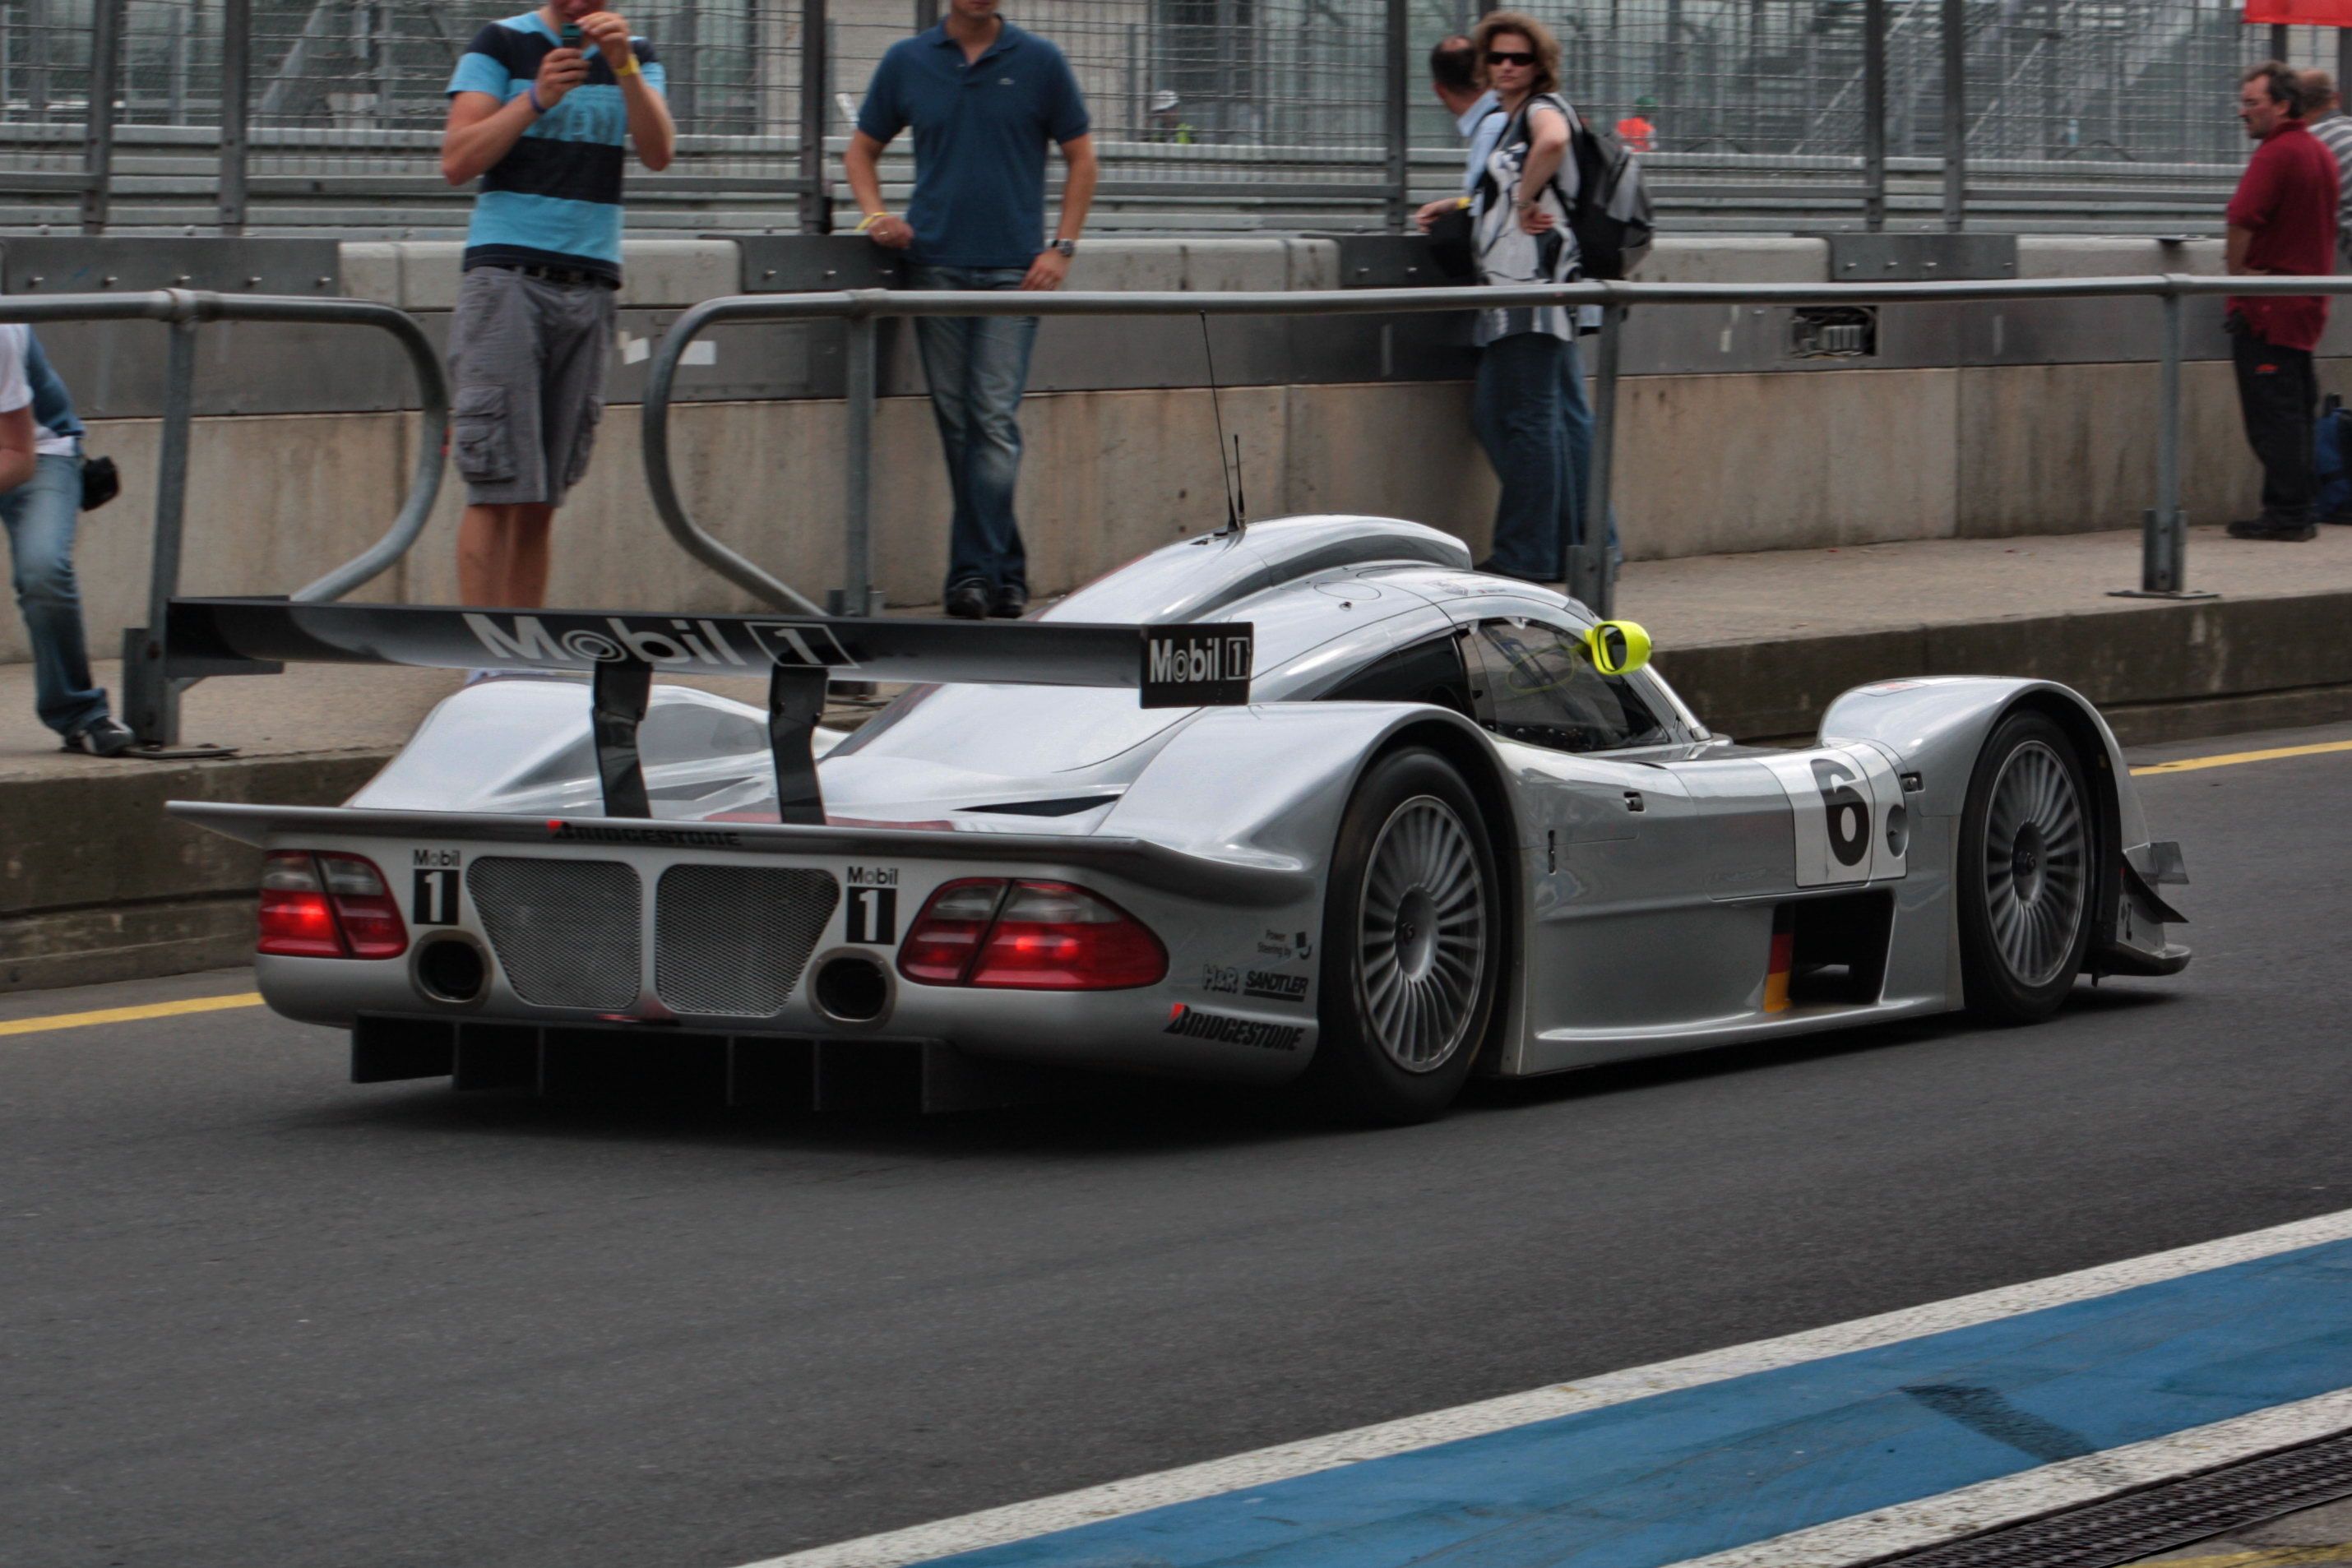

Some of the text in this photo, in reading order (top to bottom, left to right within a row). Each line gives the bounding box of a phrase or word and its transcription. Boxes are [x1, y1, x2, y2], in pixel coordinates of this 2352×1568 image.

[461, 613, 822, 665] Mobil 1
[1150, 637, 1220, 683] Mobil
[547, 819, 743, 847] BRIDGESTONE
[1810, 758, 1870, 867] 6
[414, 849, 461, 867] Mobil
[847, 867, 899, 885] Mobil
[424, 872, 443, 923] 1
[859, 890, 878, 941] 1
[1245, 969, 1310, 995] SANDTLER
[1163, 1002, 1306, 1051] BRIDGESTONE
